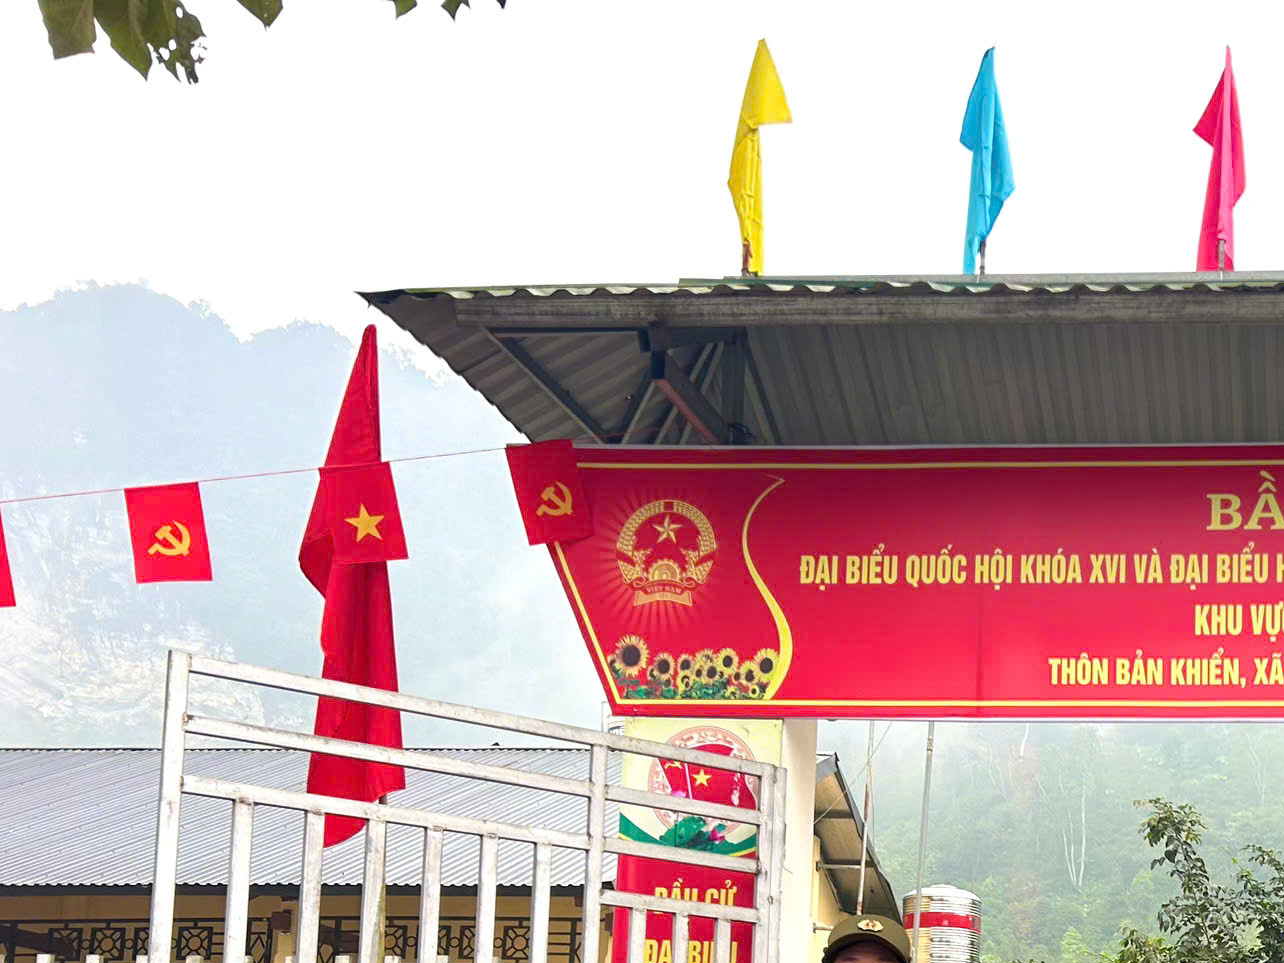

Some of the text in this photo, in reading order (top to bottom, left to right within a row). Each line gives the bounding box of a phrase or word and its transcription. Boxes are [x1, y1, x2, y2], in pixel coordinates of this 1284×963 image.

[799, 555, 839, 591] ĐẠI
[845, 543, 899, 585] BIỂU
[905, 543, 968, 588] QUỐC
[974, 548, 1013, 591] HỘI
[1020, 547, 1083, 585] KHÓA
[1088, 553, 1127, 584] XVI
[1133, 547, 1164, 584] VÀ
[1169, 553, 1209, 591] ĐẠI
[1215, 541, 1269, 584] BIỂU
[1194, 603, 1244, 637] KHU
[1047, 651, 1109, 686] THÔN
[1115, 648, 1164, 686] BẢN
[1170, 646, 1247, 689] KHIỂN,
[1253, 651, 1284, 686] XÃ
